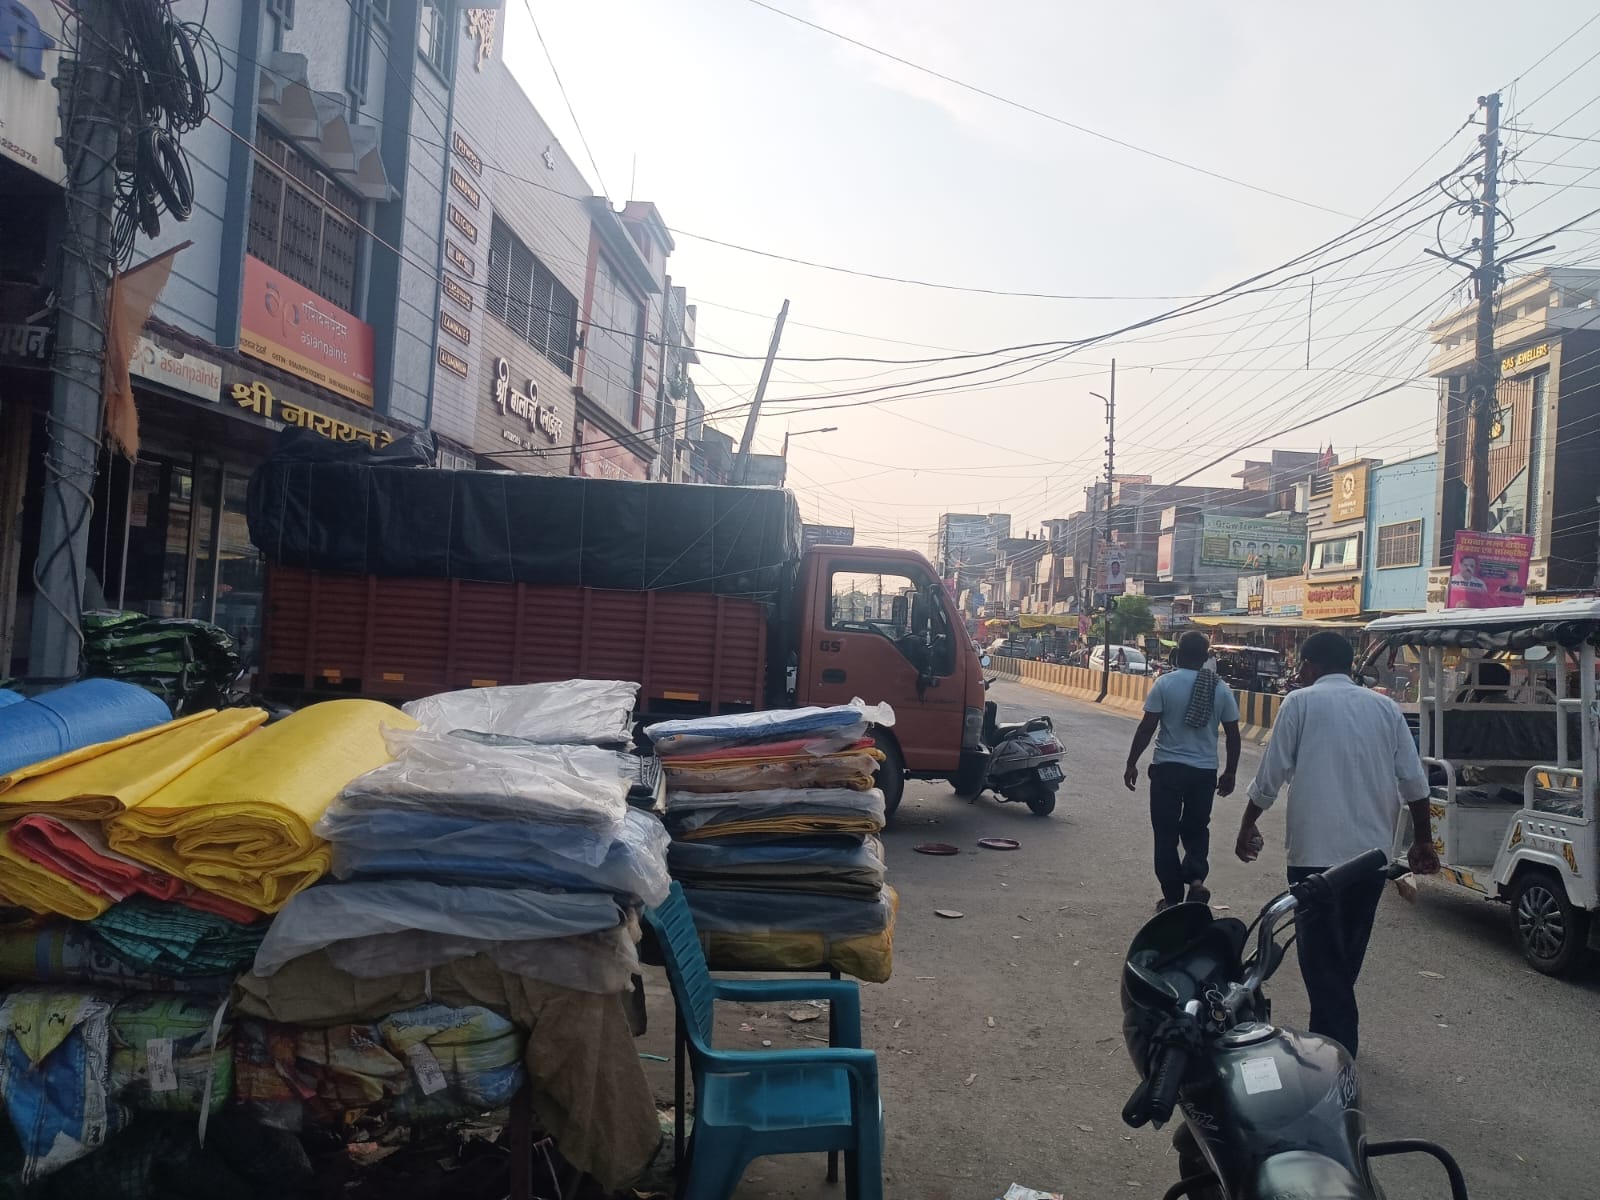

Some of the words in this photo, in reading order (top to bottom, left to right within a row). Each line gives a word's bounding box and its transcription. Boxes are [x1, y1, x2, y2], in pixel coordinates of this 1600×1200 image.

[160, 357, 219, 390] asianpaints
[230, 381, 275, 418] श्री
[819, 640, 842, 652] GS
